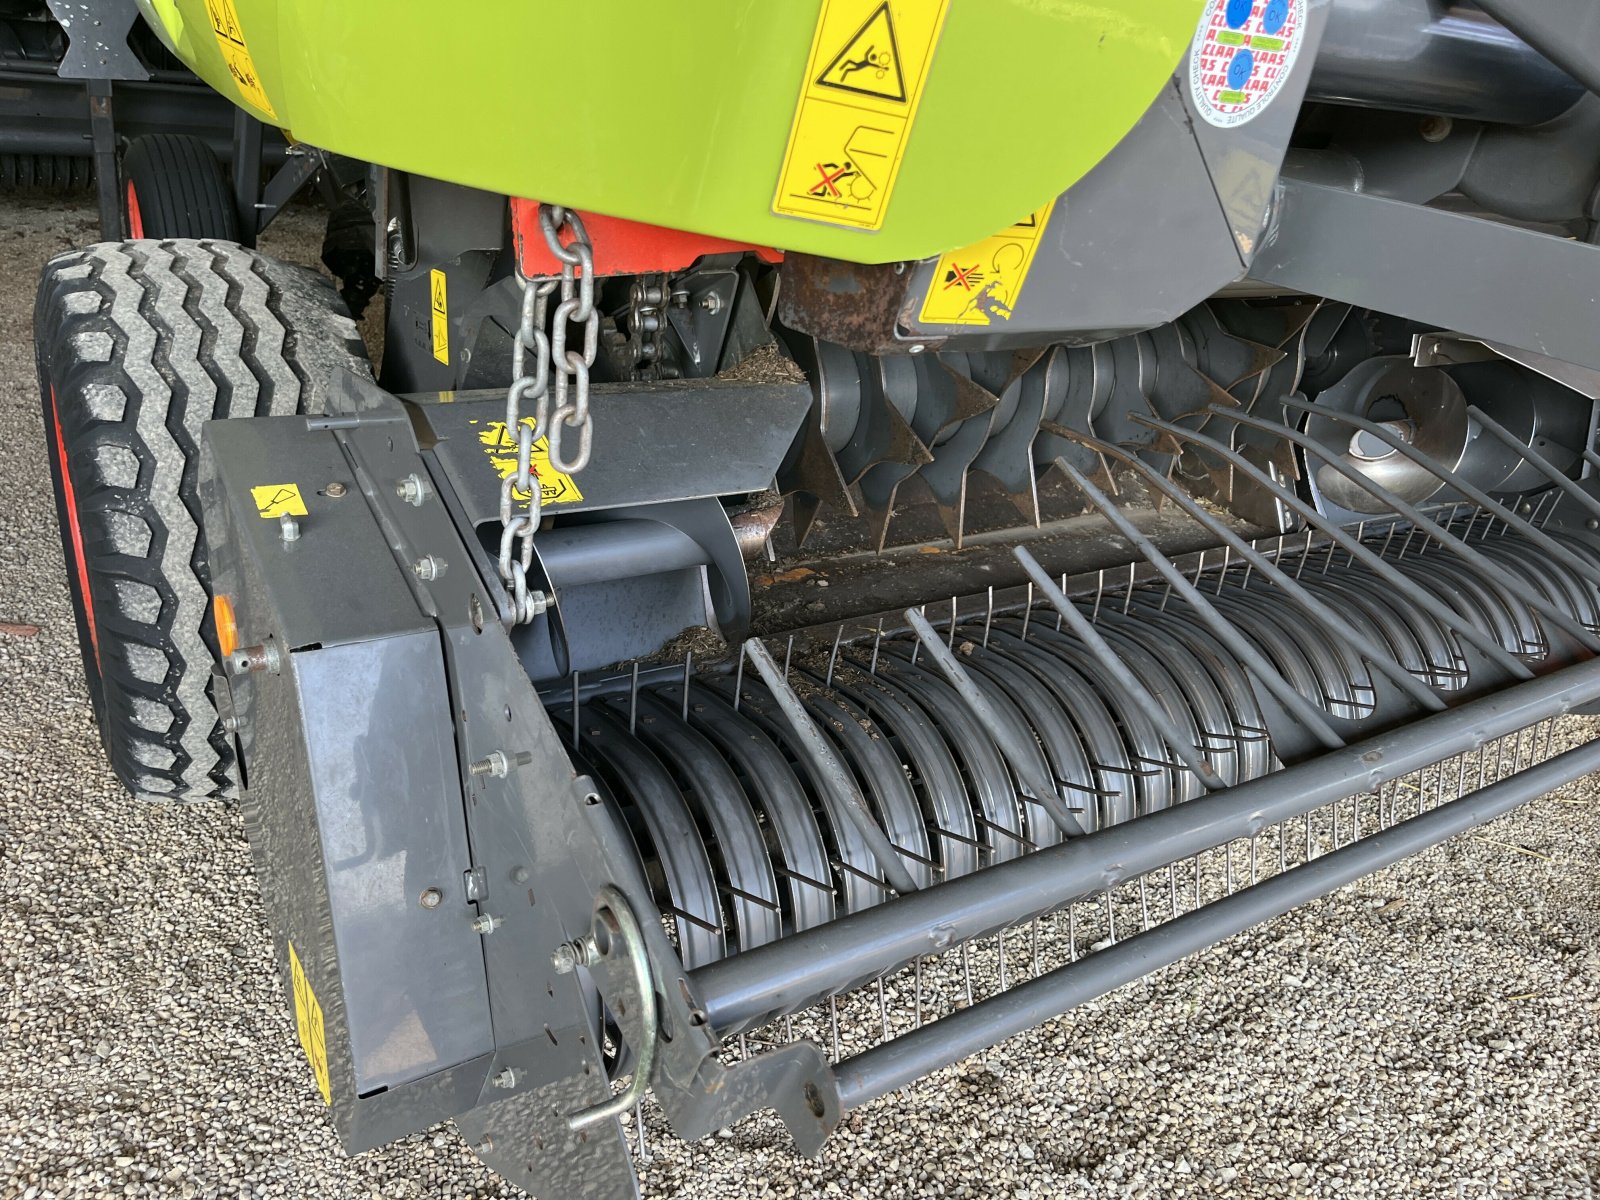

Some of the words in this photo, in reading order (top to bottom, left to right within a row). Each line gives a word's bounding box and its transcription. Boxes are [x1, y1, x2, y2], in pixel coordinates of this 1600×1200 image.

[1234, 0, 1246, 11] OK
[1268, 10, 1281, 23] OK
[1192, 49, 1200, 85] CHECK
[1233, 64, 1246, 80] OK
[1256, 65, 1289, 110] CONTROLE
[1195, 85, 1212, 116] QUALITY
